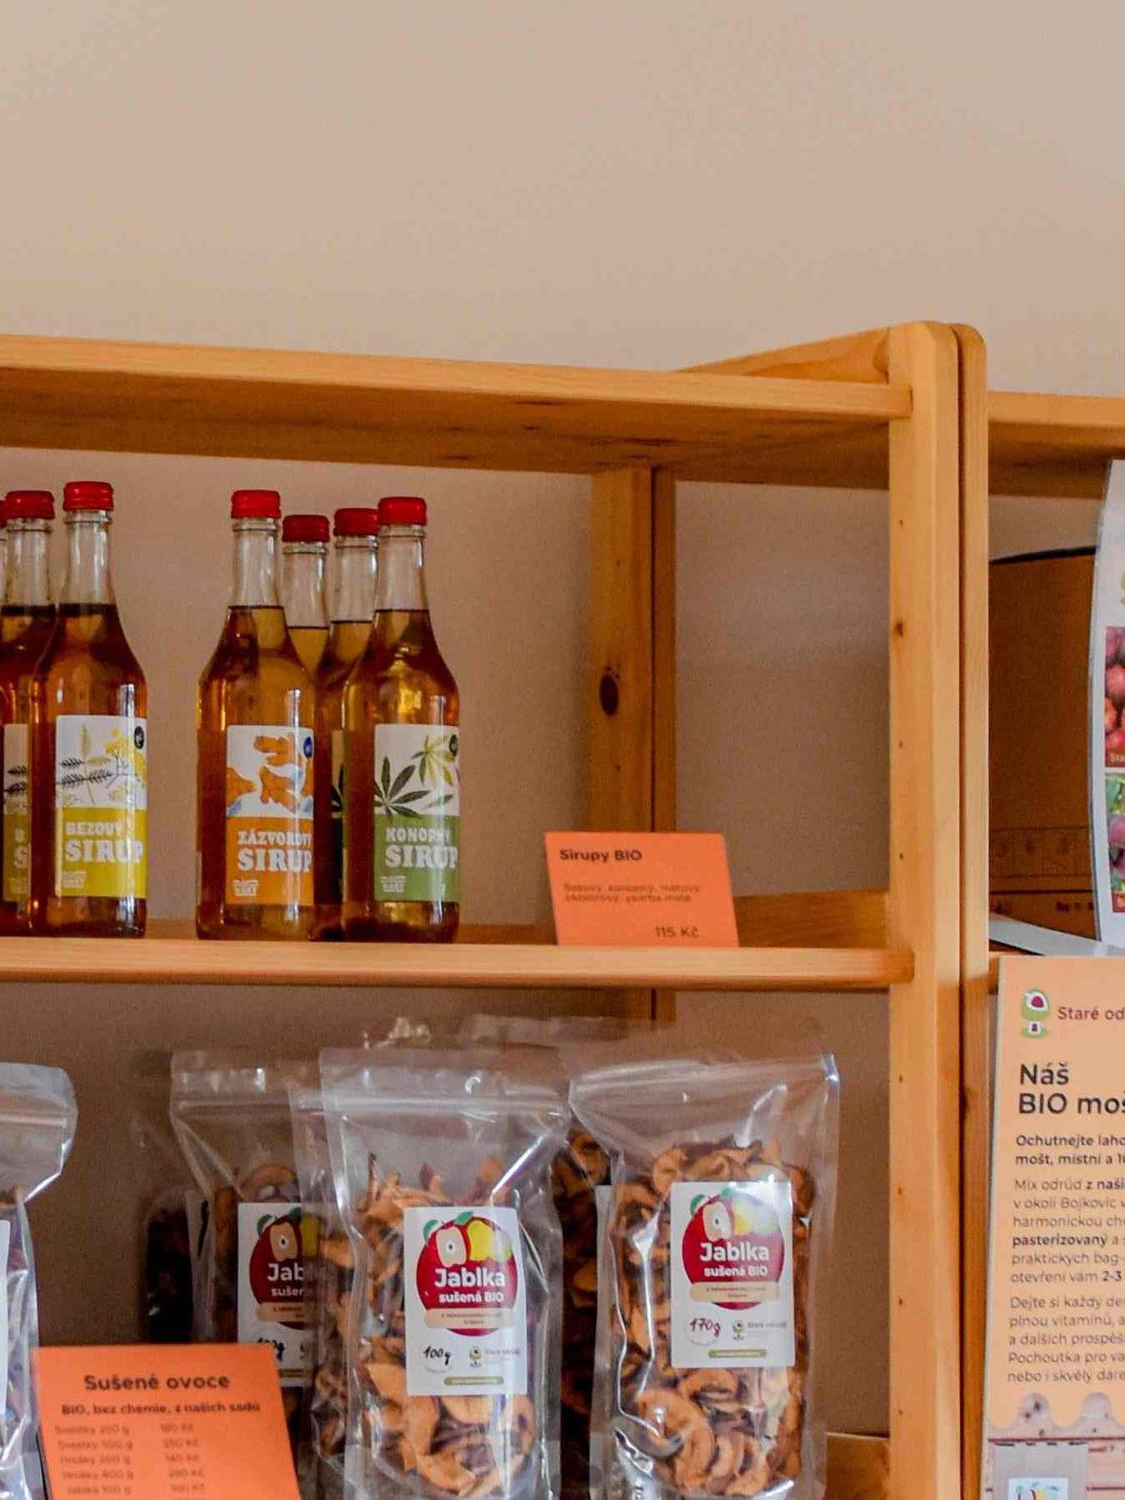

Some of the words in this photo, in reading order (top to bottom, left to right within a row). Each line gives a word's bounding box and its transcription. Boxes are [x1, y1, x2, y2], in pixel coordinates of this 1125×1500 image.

[65, 840, 143, 863] SIRUP
[560, 850, 609, 862] Sirupy
[614, 850, 642, 861] BIO
[1057, 1006, 1099, 1020] Staré
[1019, 1062, 1070, 1085] Náš
[1019, 1092, 1068, 1114] BIO
[1015, 1134, 1094, 1149] Ochutnejte
[1015, 1153, 1054, 1166] mošt,
[1057, 1154, 1101, 1165] místní
[1085, 1181, 1093, 1190] z
[1012, 1233, 1108, 1249] pasterizovaný
[700, 1243, 770, 1262] Jablka
[434, 1267, 506, 1288] Jablka
[704, 1266, 746, 1277] sušená
[748, 1266, 768, 1276] BIO
[1101, 1270, 1122, 1282] 2-3
[438, 1291, 483, 1303] sušená
[484, 1292, 503, 1303] BIO
[84, 1373, 159, 1391] Sušené
[167, 1375, 230, 1389] ovoce
[94, 1404, 116, 1414] bez
